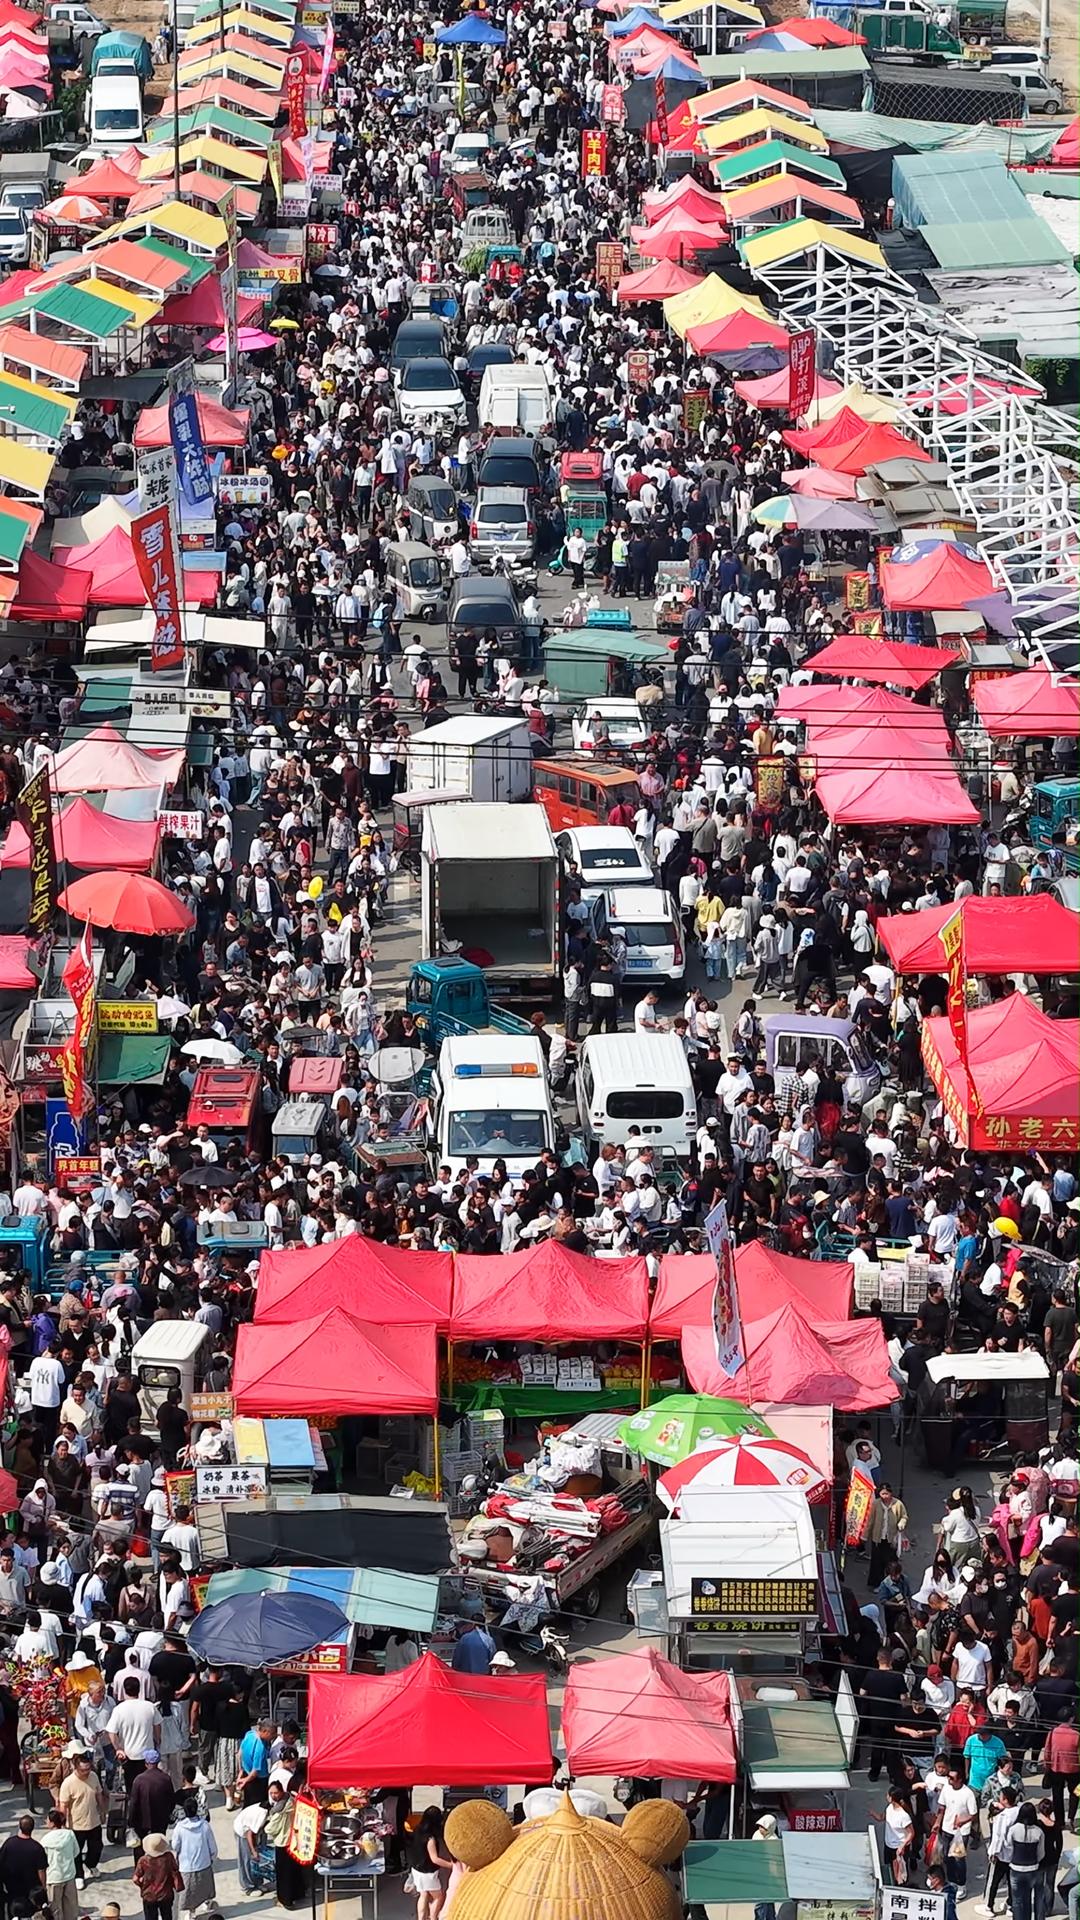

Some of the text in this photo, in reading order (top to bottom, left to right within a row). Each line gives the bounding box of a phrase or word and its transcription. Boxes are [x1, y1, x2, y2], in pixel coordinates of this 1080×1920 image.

[797, 336, 811, 394] 驴打滚
[158, 813, 200, 831] 鲜榨果汁
[985, 1115, 1077, 1139] 孙老六
[203, 1470, 251, 1482] 奶茶 果茶
[202, 1485, 221, 1495] 冰粉
[794, 1815, 838, 1831] 酸辣鸡爪
